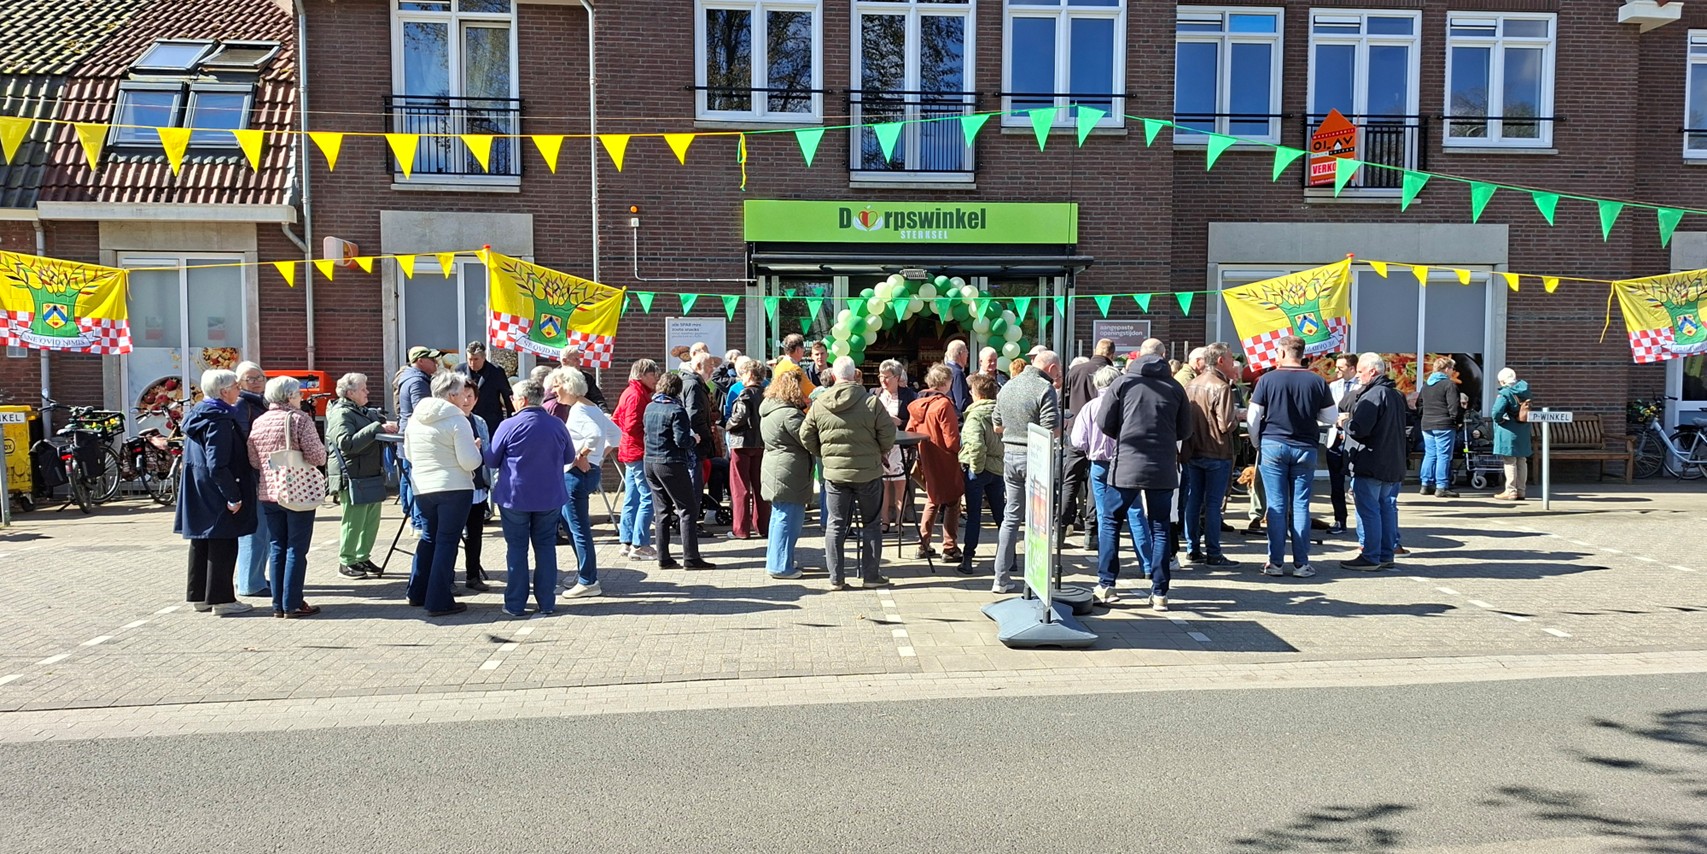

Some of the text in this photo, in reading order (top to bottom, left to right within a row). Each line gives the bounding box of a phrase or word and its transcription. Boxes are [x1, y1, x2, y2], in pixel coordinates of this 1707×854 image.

[1313, 136, 1353, 150] OLAV
[1312, 162, 1337, 174] VERKO
[900, 230, 948, 239] STERKSEL
[0, 414, 21, 422] KEL
[1533, 413, 1570, 421] P-WINKEL
